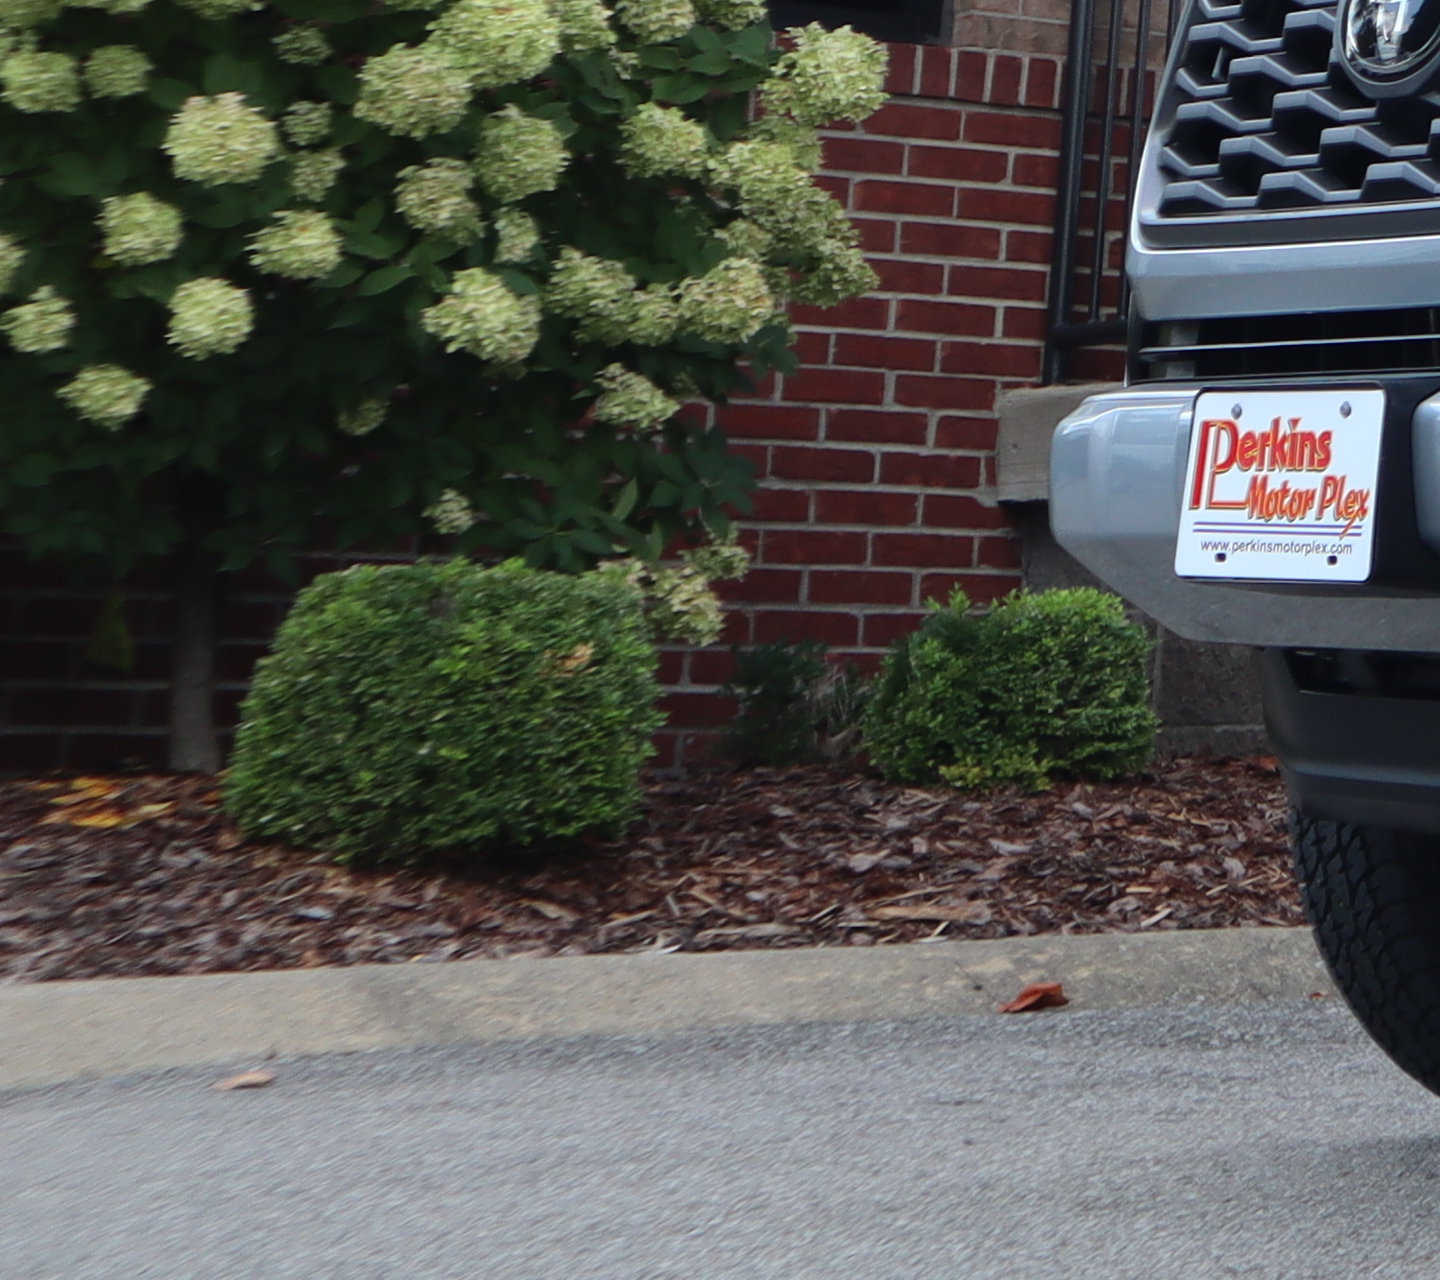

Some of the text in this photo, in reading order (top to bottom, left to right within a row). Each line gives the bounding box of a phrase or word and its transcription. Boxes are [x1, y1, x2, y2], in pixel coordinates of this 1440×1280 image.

[1189, 416, 1334, 510] Perkins
[1247, 475, 1370, 539] Motor Plex
[1200, 539, 1353, 557] www.perkinsmotorplex.com
